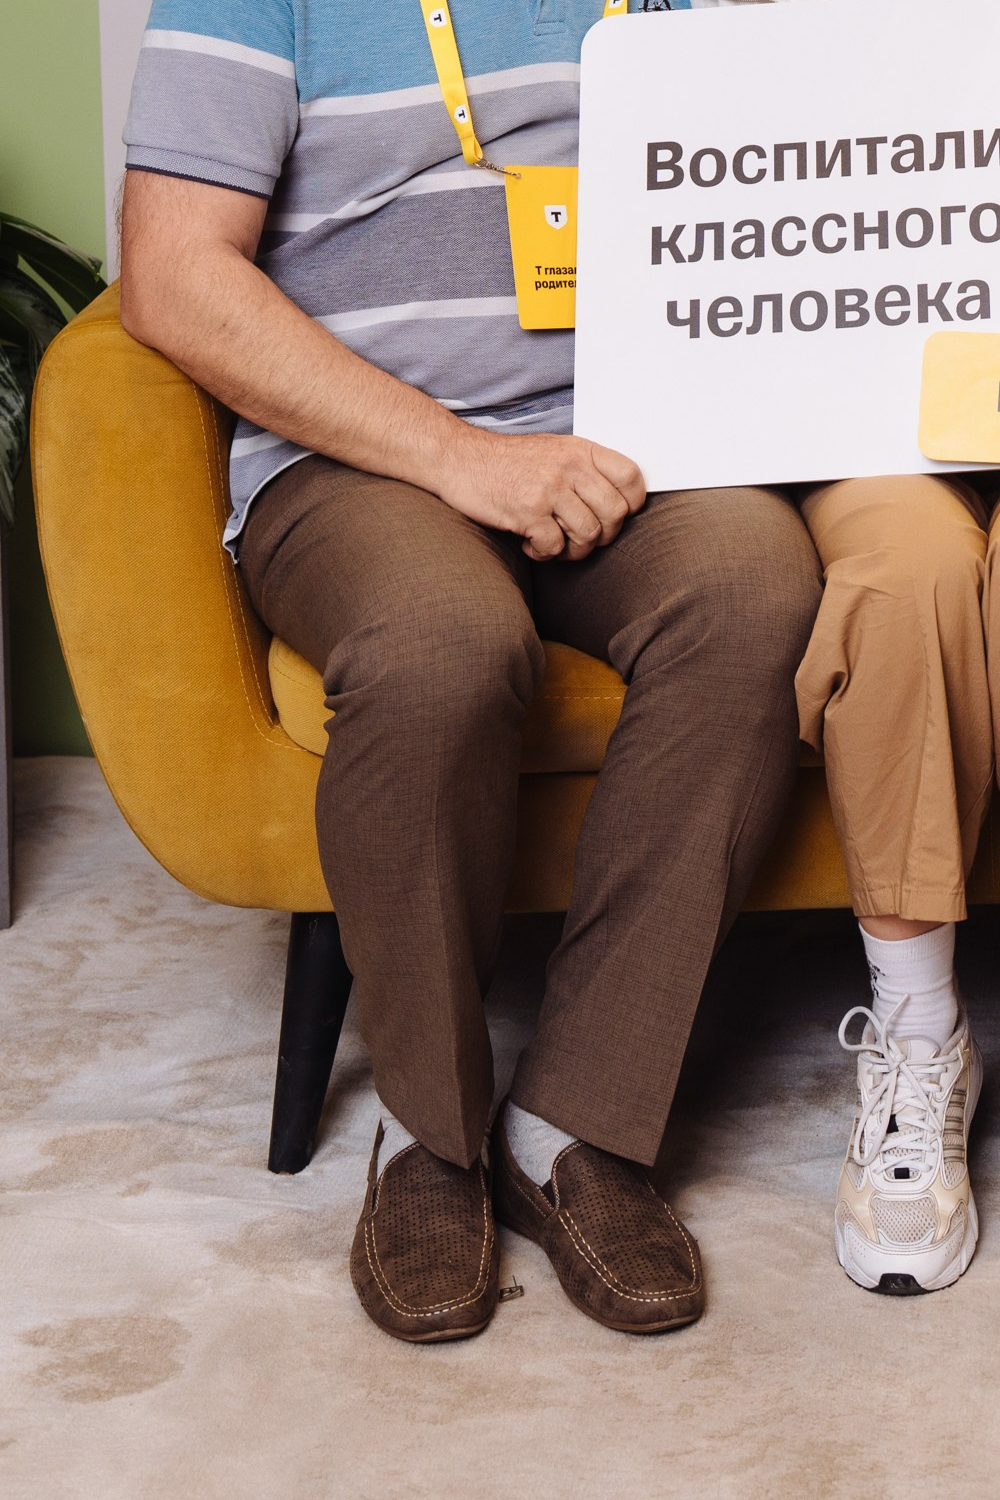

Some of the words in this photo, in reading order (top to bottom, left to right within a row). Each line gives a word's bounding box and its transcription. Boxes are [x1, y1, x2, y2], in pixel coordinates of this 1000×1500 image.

[544, 266, 577, 276] глаза
[535, 280, 577, 291] родите
[666, 278, 991, 339] человека
